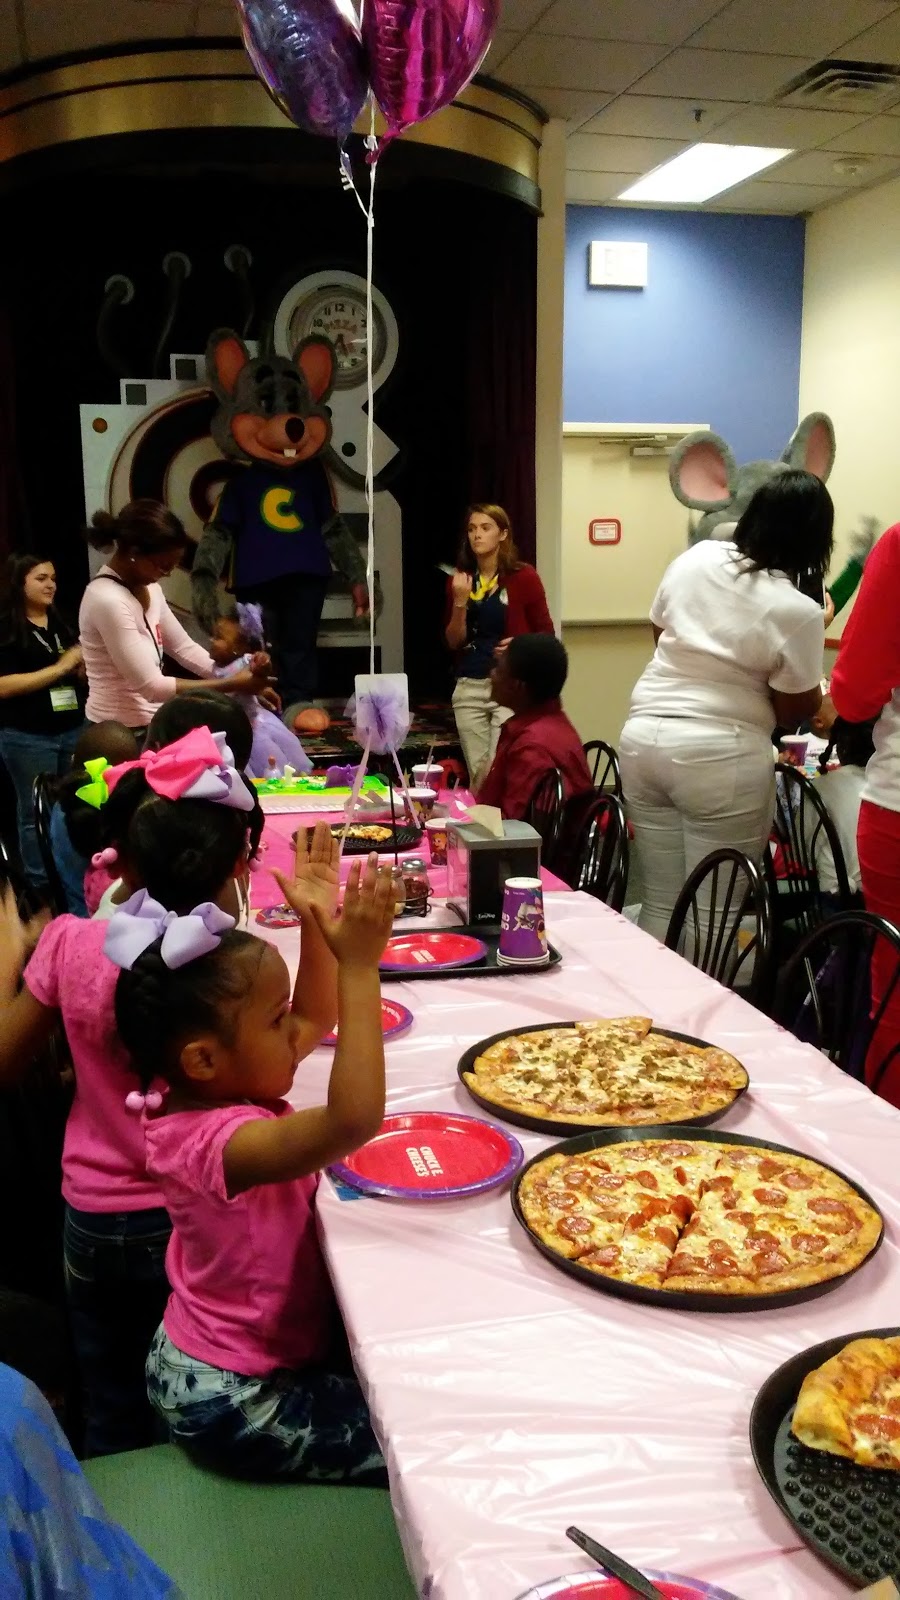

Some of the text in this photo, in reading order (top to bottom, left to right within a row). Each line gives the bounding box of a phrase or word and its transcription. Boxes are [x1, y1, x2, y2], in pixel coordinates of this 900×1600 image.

[324, 307, 331, 316] 11
[335, 303, 345, 312] 12
[313, 318, 323, 327] 10
[260, 485, 304, 533] C
[420, 1146, 444, 1176] CHUCK E
